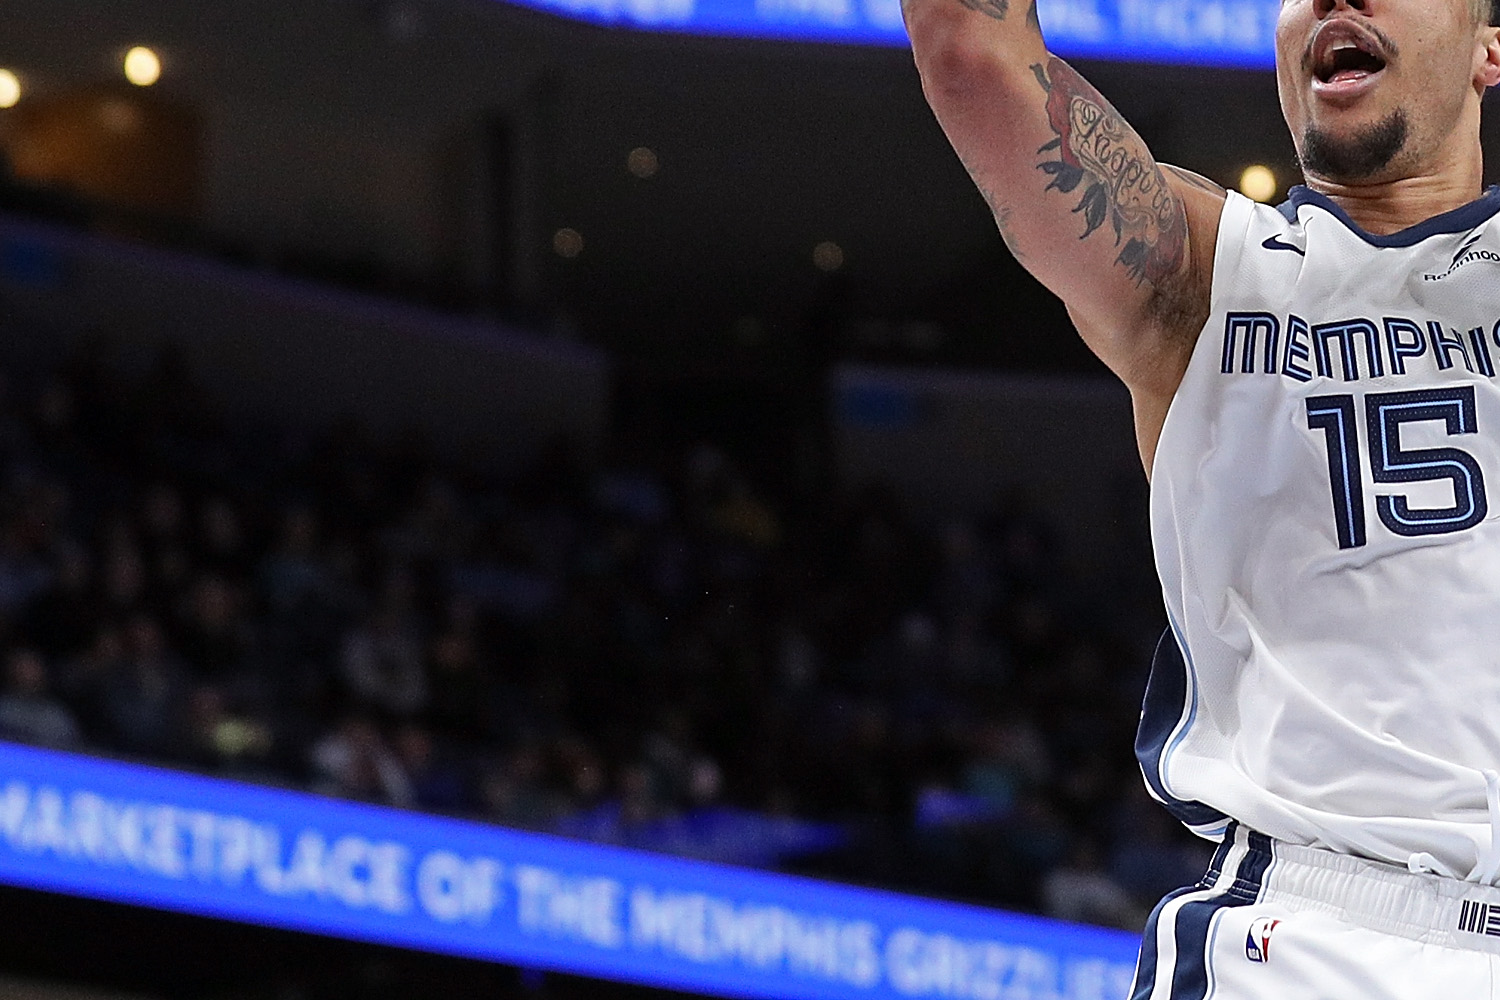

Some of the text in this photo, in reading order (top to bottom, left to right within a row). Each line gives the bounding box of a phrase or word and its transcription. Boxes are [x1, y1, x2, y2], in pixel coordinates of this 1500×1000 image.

[1304, 385, 1489, 550] 15
[417, 851, 502, 921] OF
[514, 864, 623, 949] THE
[629, 887, 882, 987] MEMPHIS
